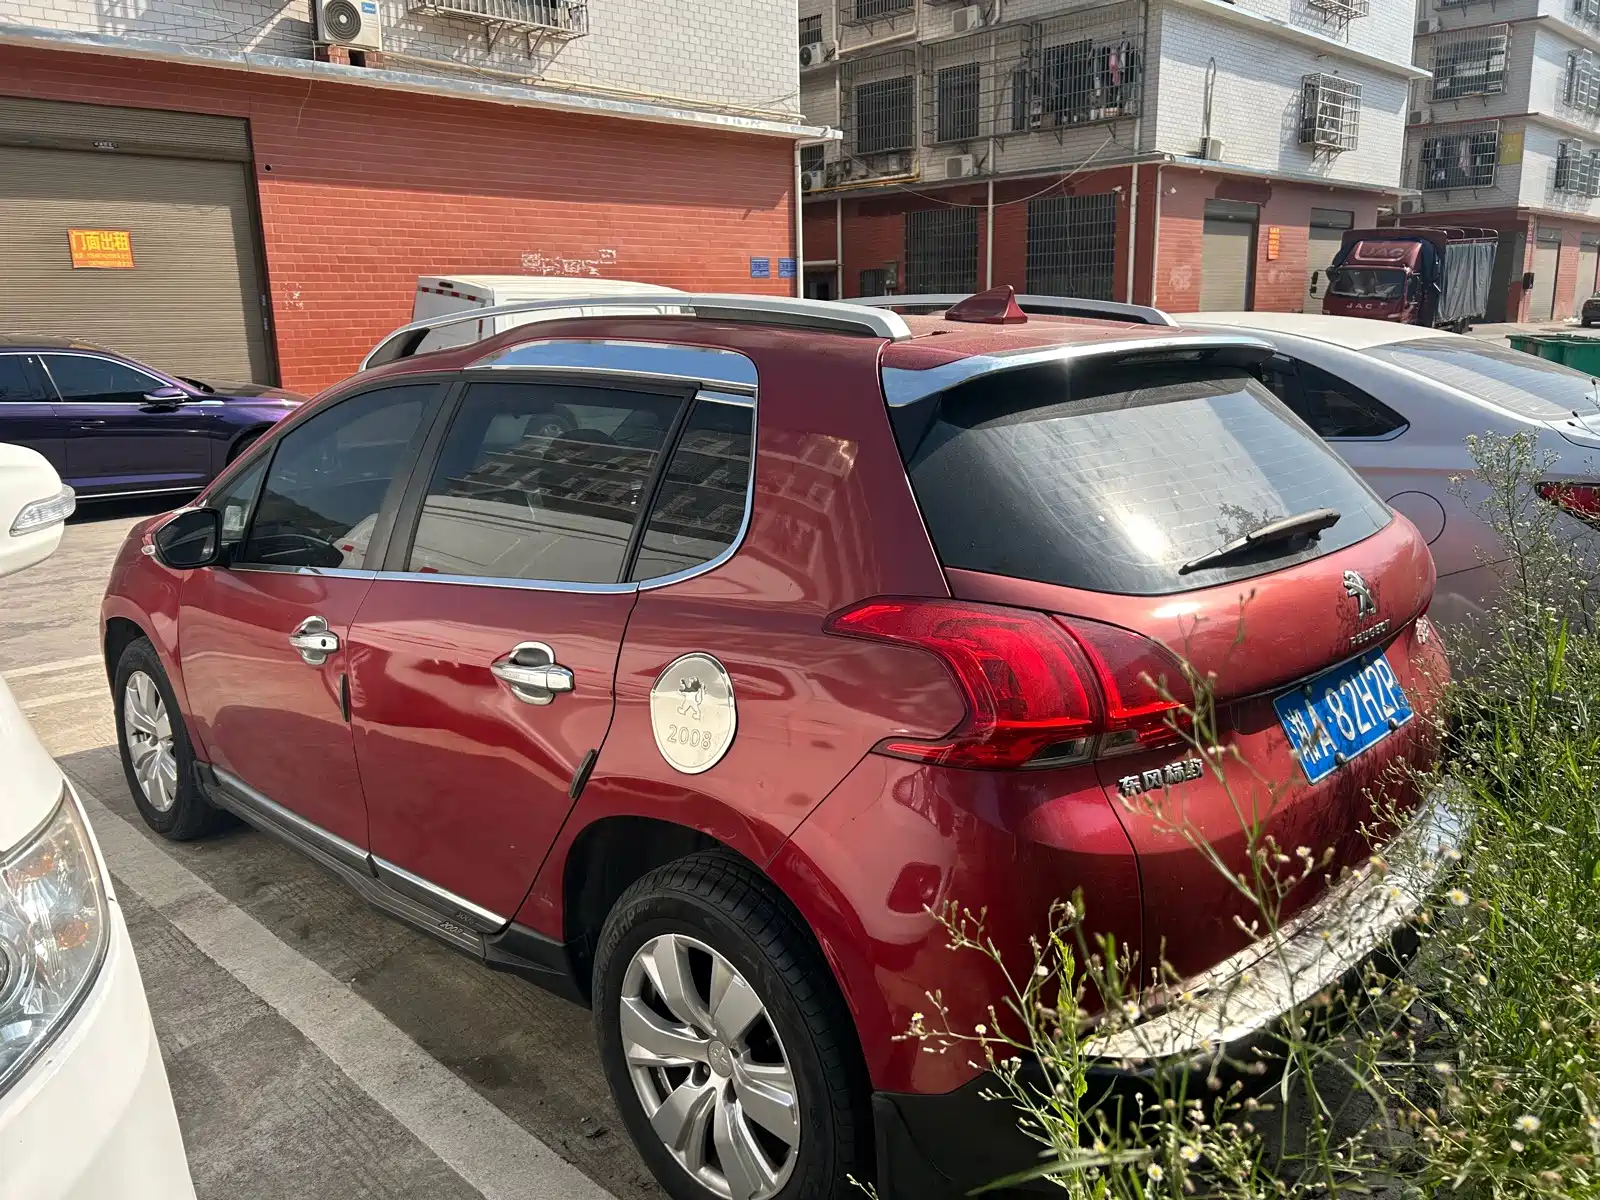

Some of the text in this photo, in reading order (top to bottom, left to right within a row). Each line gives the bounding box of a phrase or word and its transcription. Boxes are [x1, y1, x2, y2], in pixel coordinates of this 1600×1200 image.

[71, 231, 129, 251] 门面出租
[1361, 247, 1405, 257] JAC
[667, 724, 712, 751] 2008
